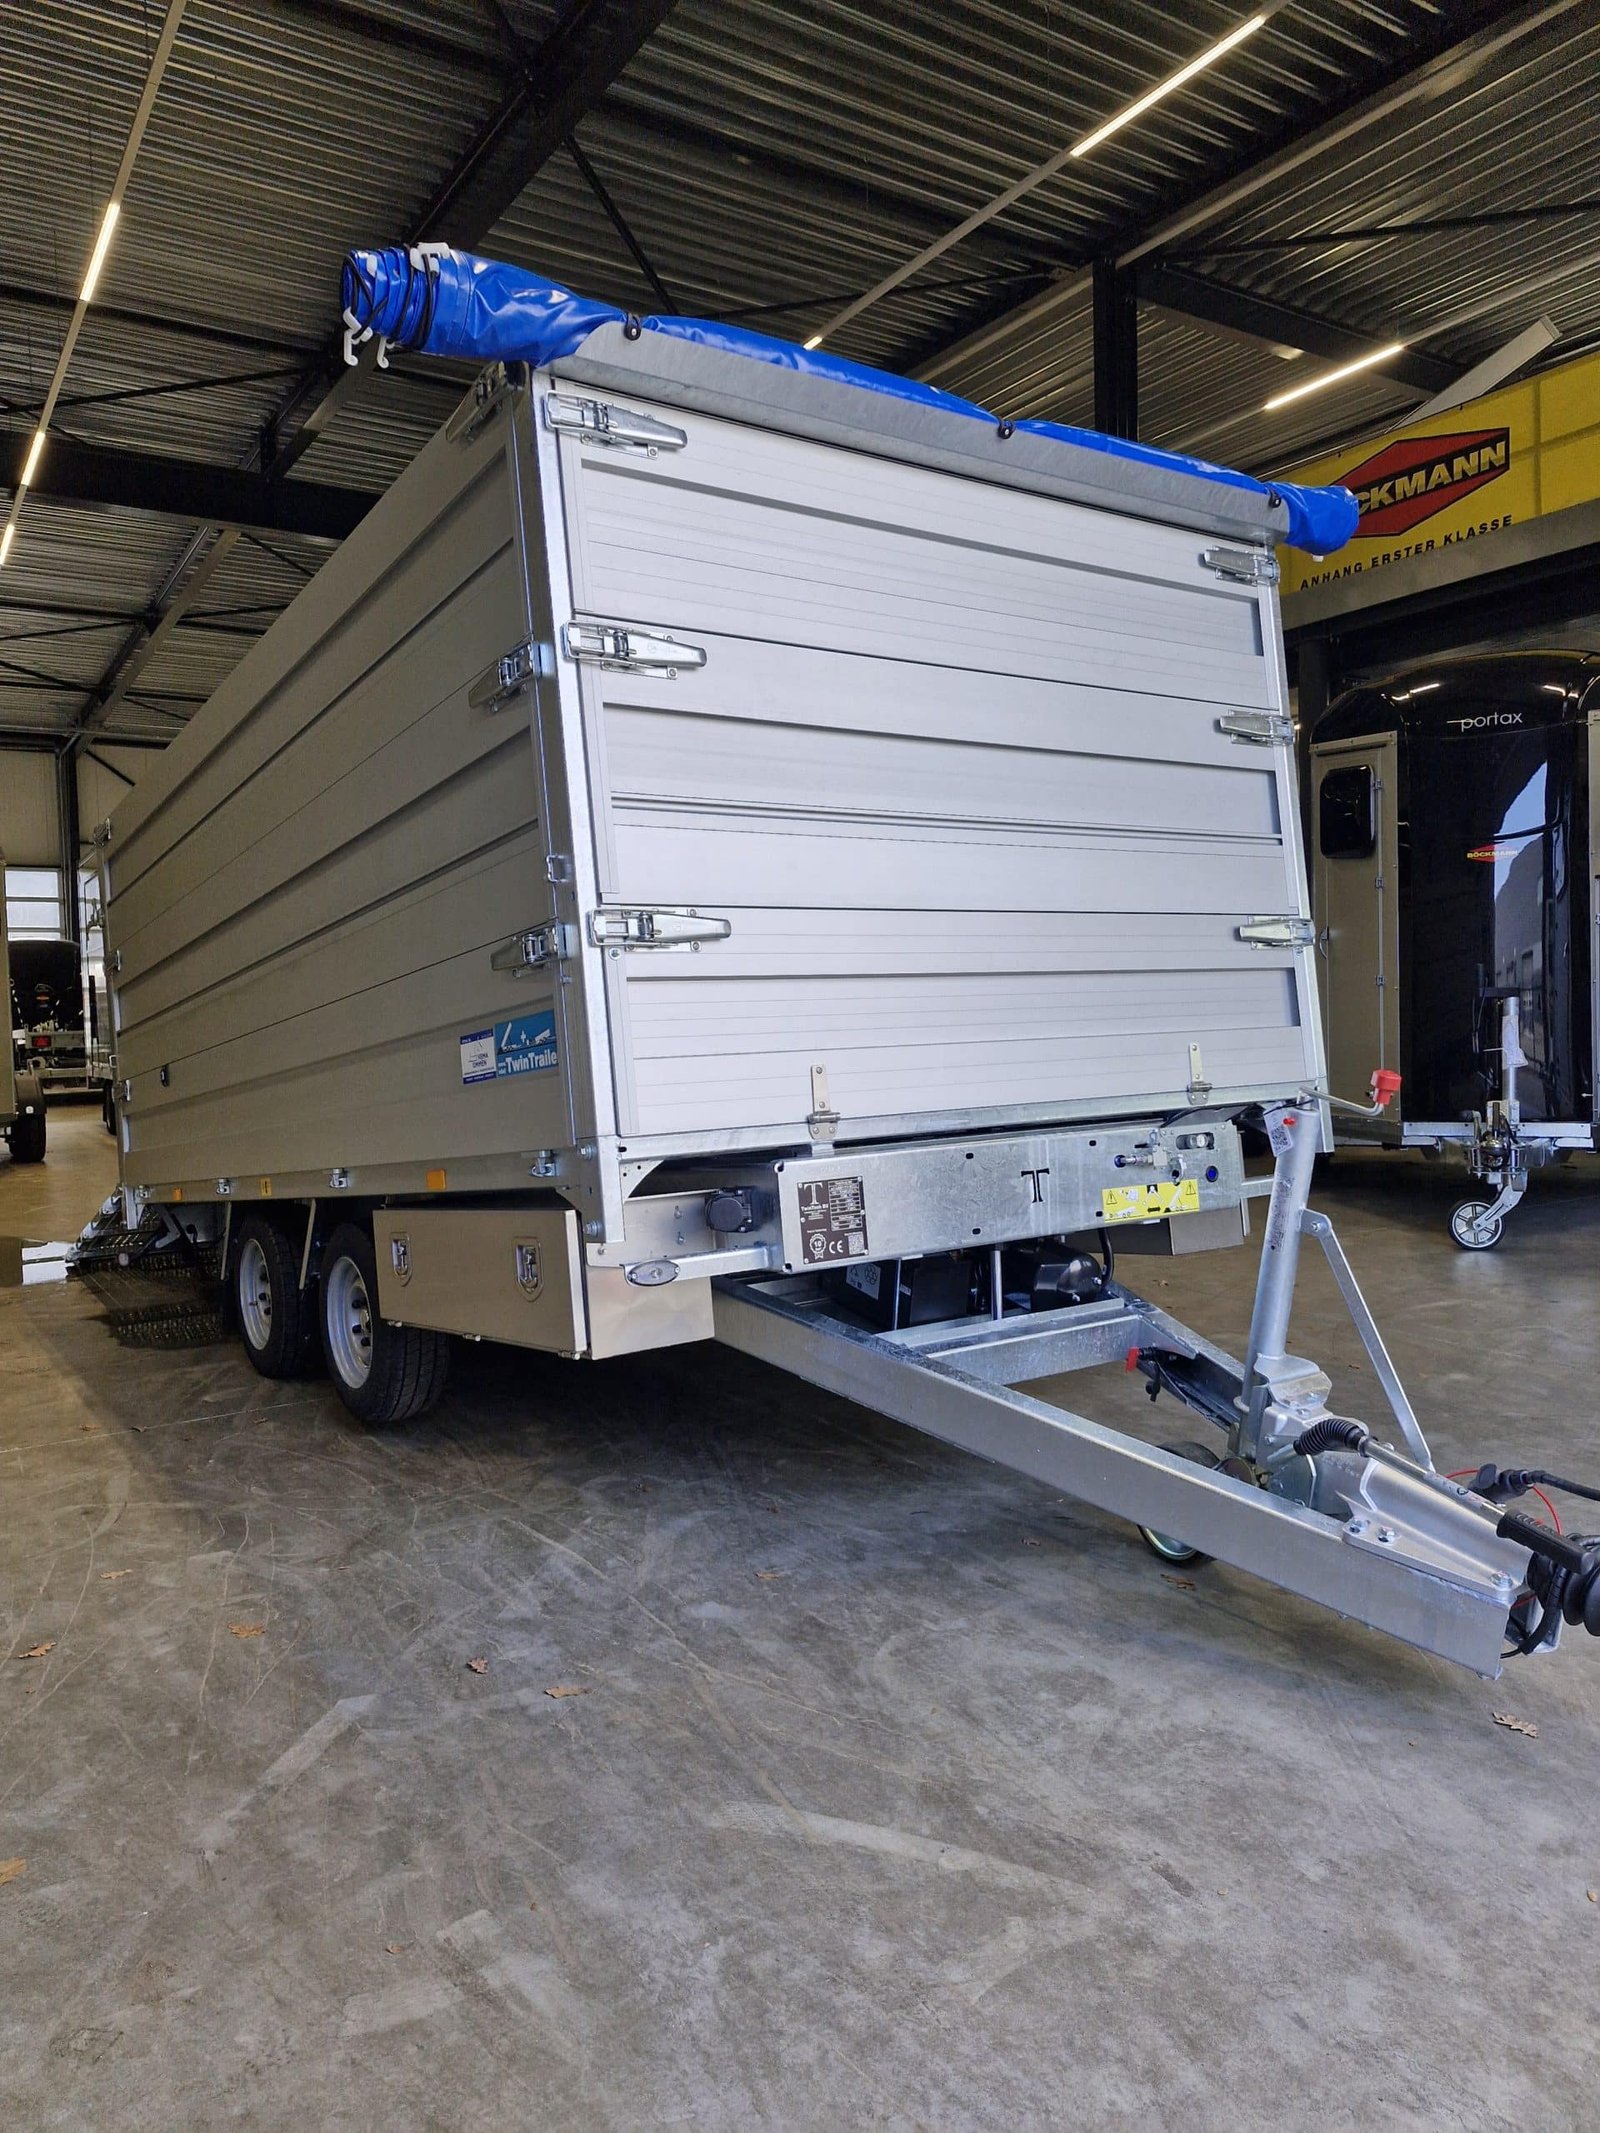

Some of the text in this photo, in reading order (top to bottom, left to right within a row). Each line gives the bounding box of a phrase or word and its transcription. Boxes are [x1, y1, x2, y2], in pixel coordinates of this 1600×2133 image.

[1358, 441, 1506, 514] CKMANN
[1301, 515, 1512, 591] ANHANG ERSTER KLASSE
[1461, 712, 1522, 732] portax
